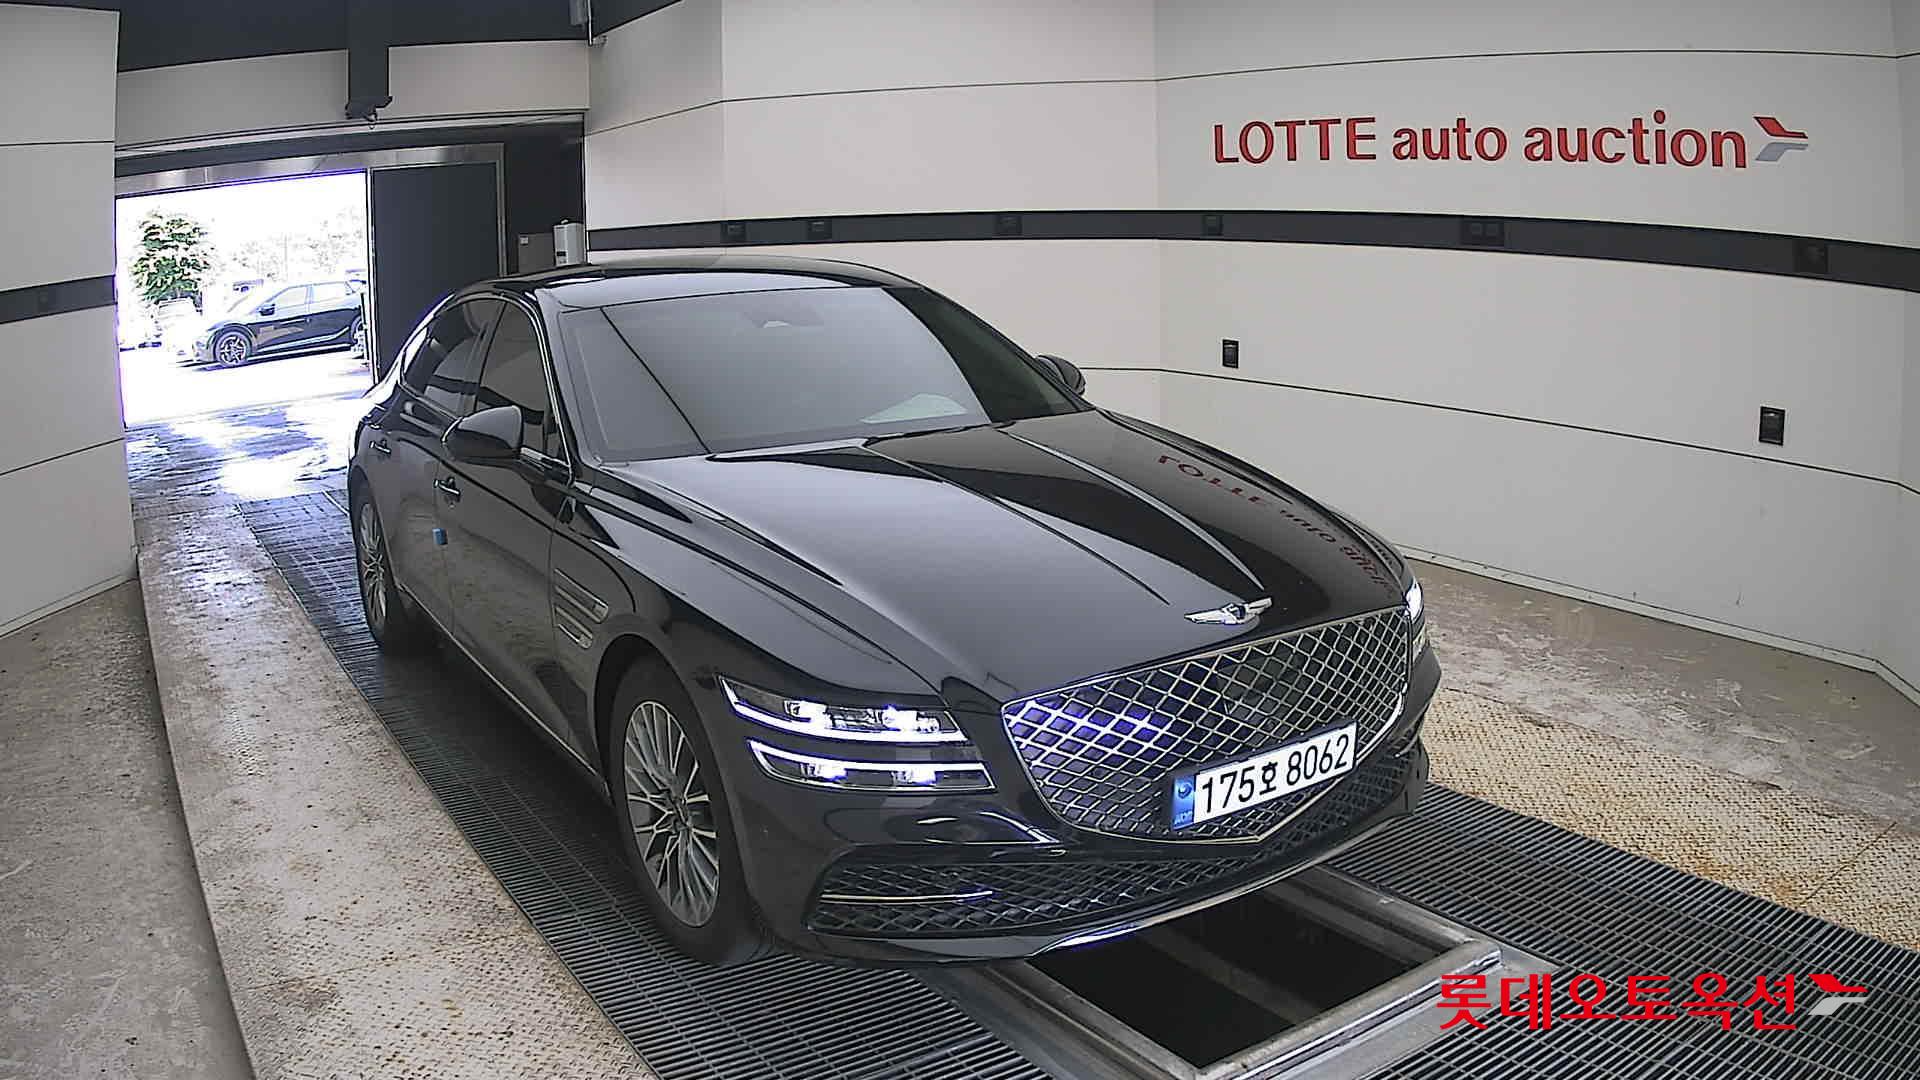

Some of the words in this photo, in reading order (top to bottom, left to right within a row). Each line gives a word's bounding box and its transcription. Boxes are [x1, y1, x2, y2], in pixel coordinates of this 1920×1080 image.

[1213, 116, 1377, 164] LOTTE
[1391, 116, 1508, 162] auto
[1523, 109, 1748, 168] auction
[1202, 761, 1279, 814] 175호
[1286, 733, 1350, 787] 8062
